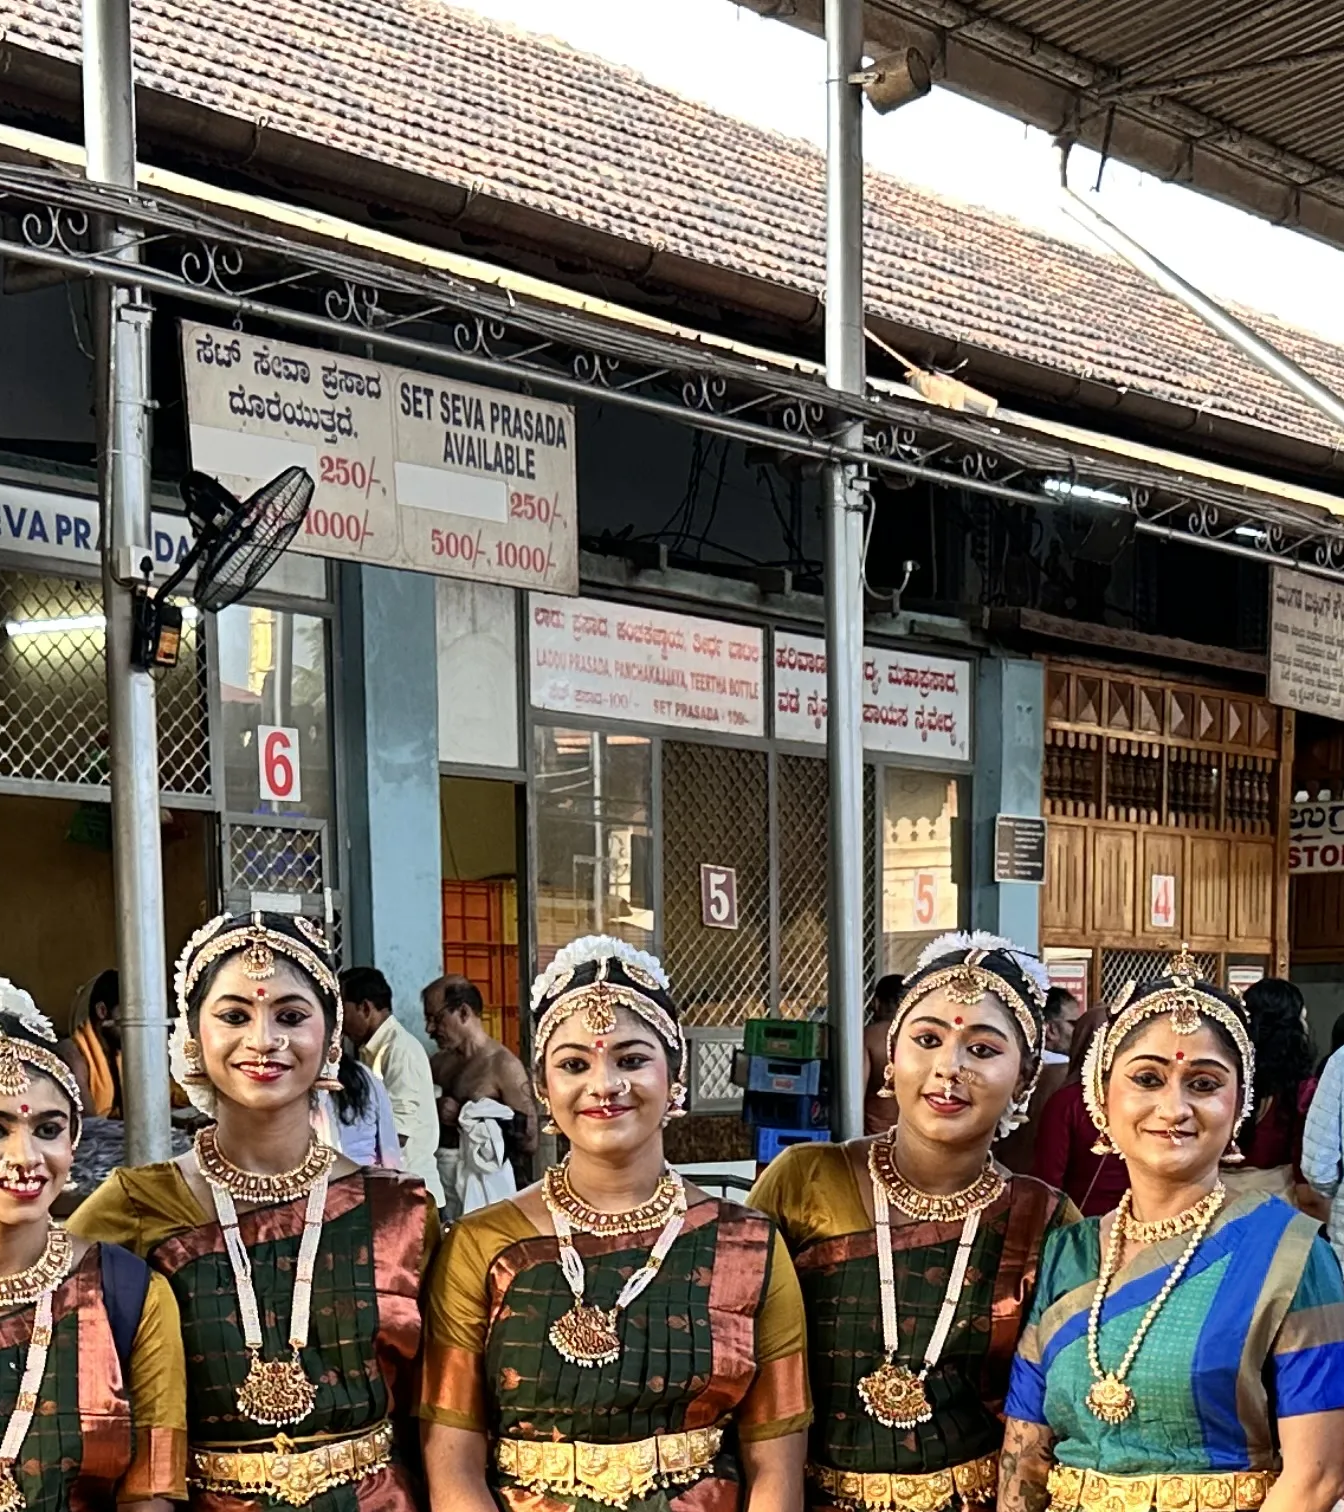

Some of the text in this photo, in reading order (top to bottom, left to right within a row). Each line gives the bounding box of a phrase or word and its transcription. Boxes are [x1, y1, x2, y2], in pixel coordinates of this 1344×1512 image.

[196, 333, 382, 400] ಸೆಟ್ ಸೇವಾ ಪ್ರಸಾದ
[400, 382, 567, 449] SET SEVA PRASADA
[443, 431, 536, 480] AVAILABLE
[496, 541, 556, 582] 1000/-
[653, 699, 672, 716] SET
[675, 702, 719, 721] PRASADA
[729, 678, 759, 699] BOTTLE
[264, 732, 294, 796] 6
[709, 872, 730, 921] 5
[916, 874, 934, 924] 5
[1154, 880, 1171, 922] 4
